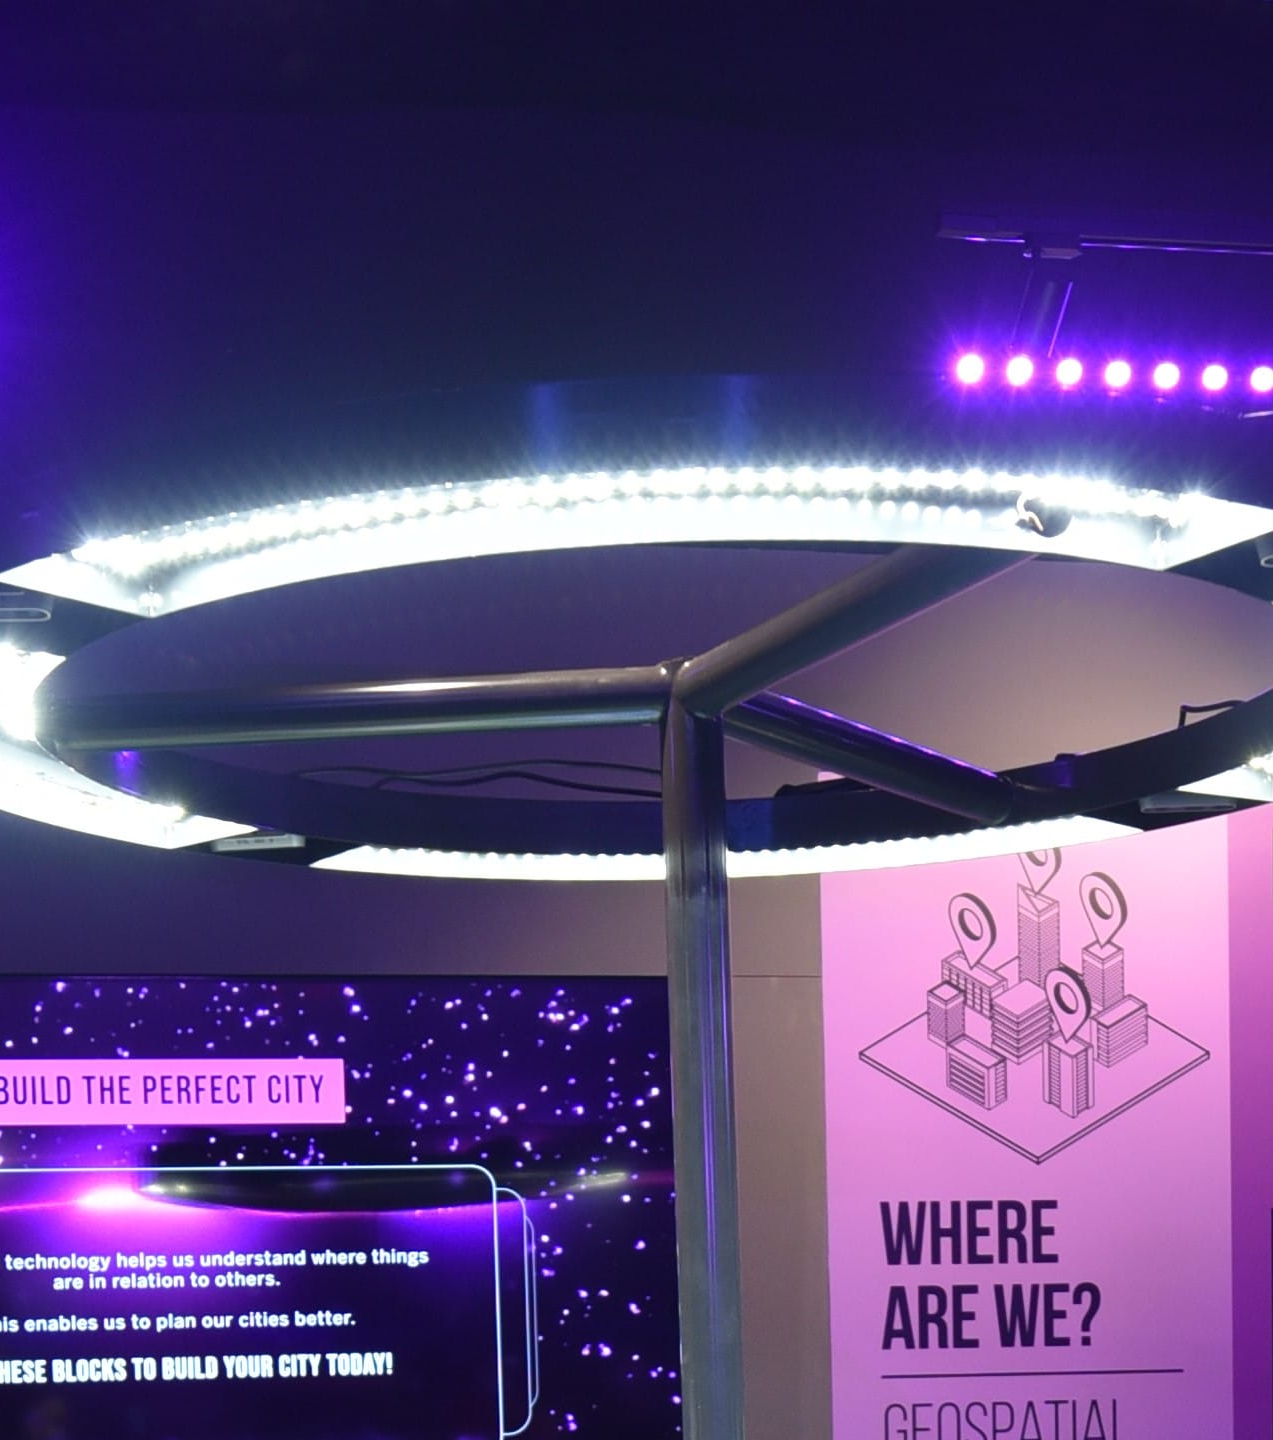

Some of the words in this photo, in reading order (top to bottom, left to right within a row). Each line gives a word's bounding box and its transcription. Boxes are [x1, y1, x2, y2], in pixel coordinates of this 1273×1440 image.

[82, 1074, 133, 1106] THE
[142, 1073, 258, 1106] PERFECT
[266, 1073, 325, 1105] CITY
[880, 1200, 1058, 1265] WHERE
[5, 1254, 111, 1273] technology
[116, 1252, 167, 1272] helps
[172, 1256, 194, 1268] us
[199, 1250, 306, 1268] understand
[310, 1250, 367, 1266] where
[370, 1248, 430, 1268] things
[53, 1277, 84, 1290] are
[89, 1273, 106, 1289] in
[111, 1272, 185, 1289] relation
[190, 1273, 210, 1288] to
[214, 1270, 281, 1288] others.
[24, 1314, 100, 1331] enables
[103, 1317, 126, 1331] us
[130, 1314, 151, 1331] to
[155, 1312, 197, 1333] plan
[201, 1315, 233, 1329] our
[238, 1310, 289, 1328] cities
[294, 1310, 356, 1327] better.
[882, 1284, 980, 1350] ARE
[993, 1282, 1101, 1347] WE?
[52, 1358, 127, 1383] BLOCKS
[131, 1357, 157, 1381] TO
[161, 1355, 219, 1381] BUILD
[222, 1354, 274, 1379] YOUR
[278, 1353, 321, 1378] CITY
[325, 1352, 393, 1376] TODAY!
